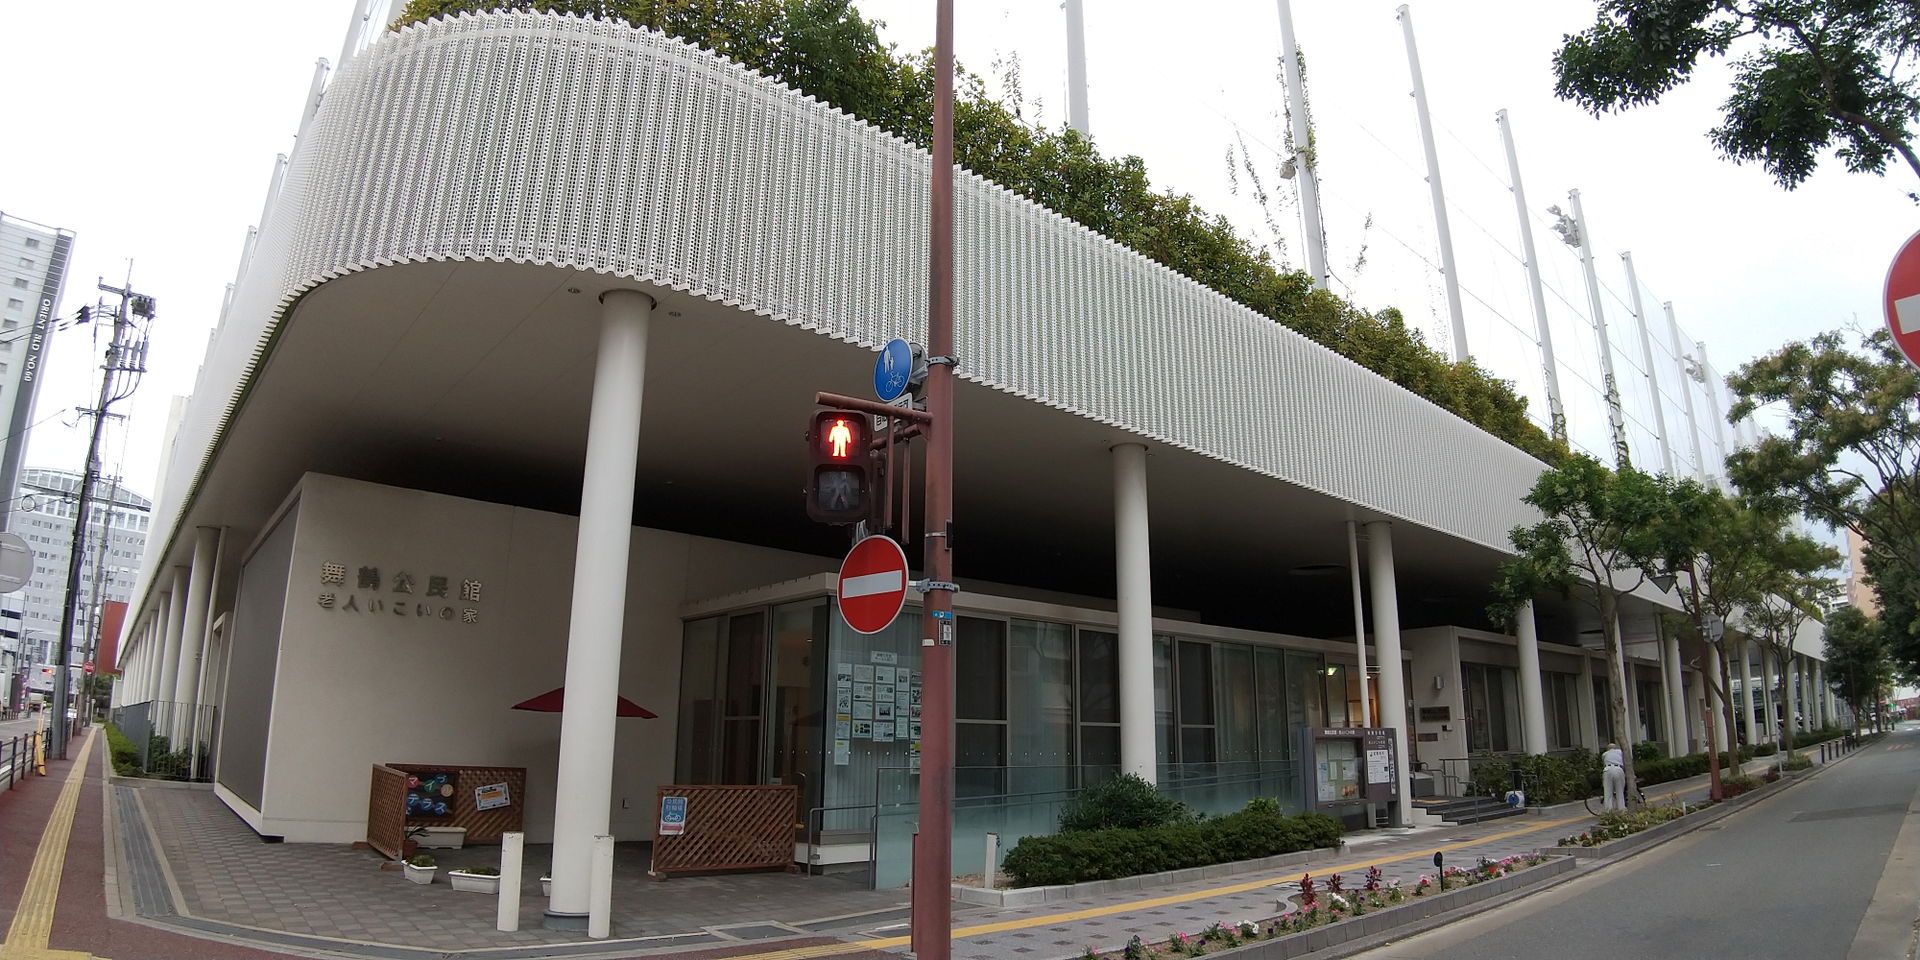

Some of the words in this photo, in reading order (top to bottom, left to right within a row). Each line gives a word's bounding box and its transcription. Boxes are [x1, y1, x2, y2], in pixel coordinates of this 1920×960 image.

[36, 298, 51, 330] ORIENT
[320, 560, 482, 602] 舞鶴公民館
[317, 593, 478, 624] 老人いこいの家
